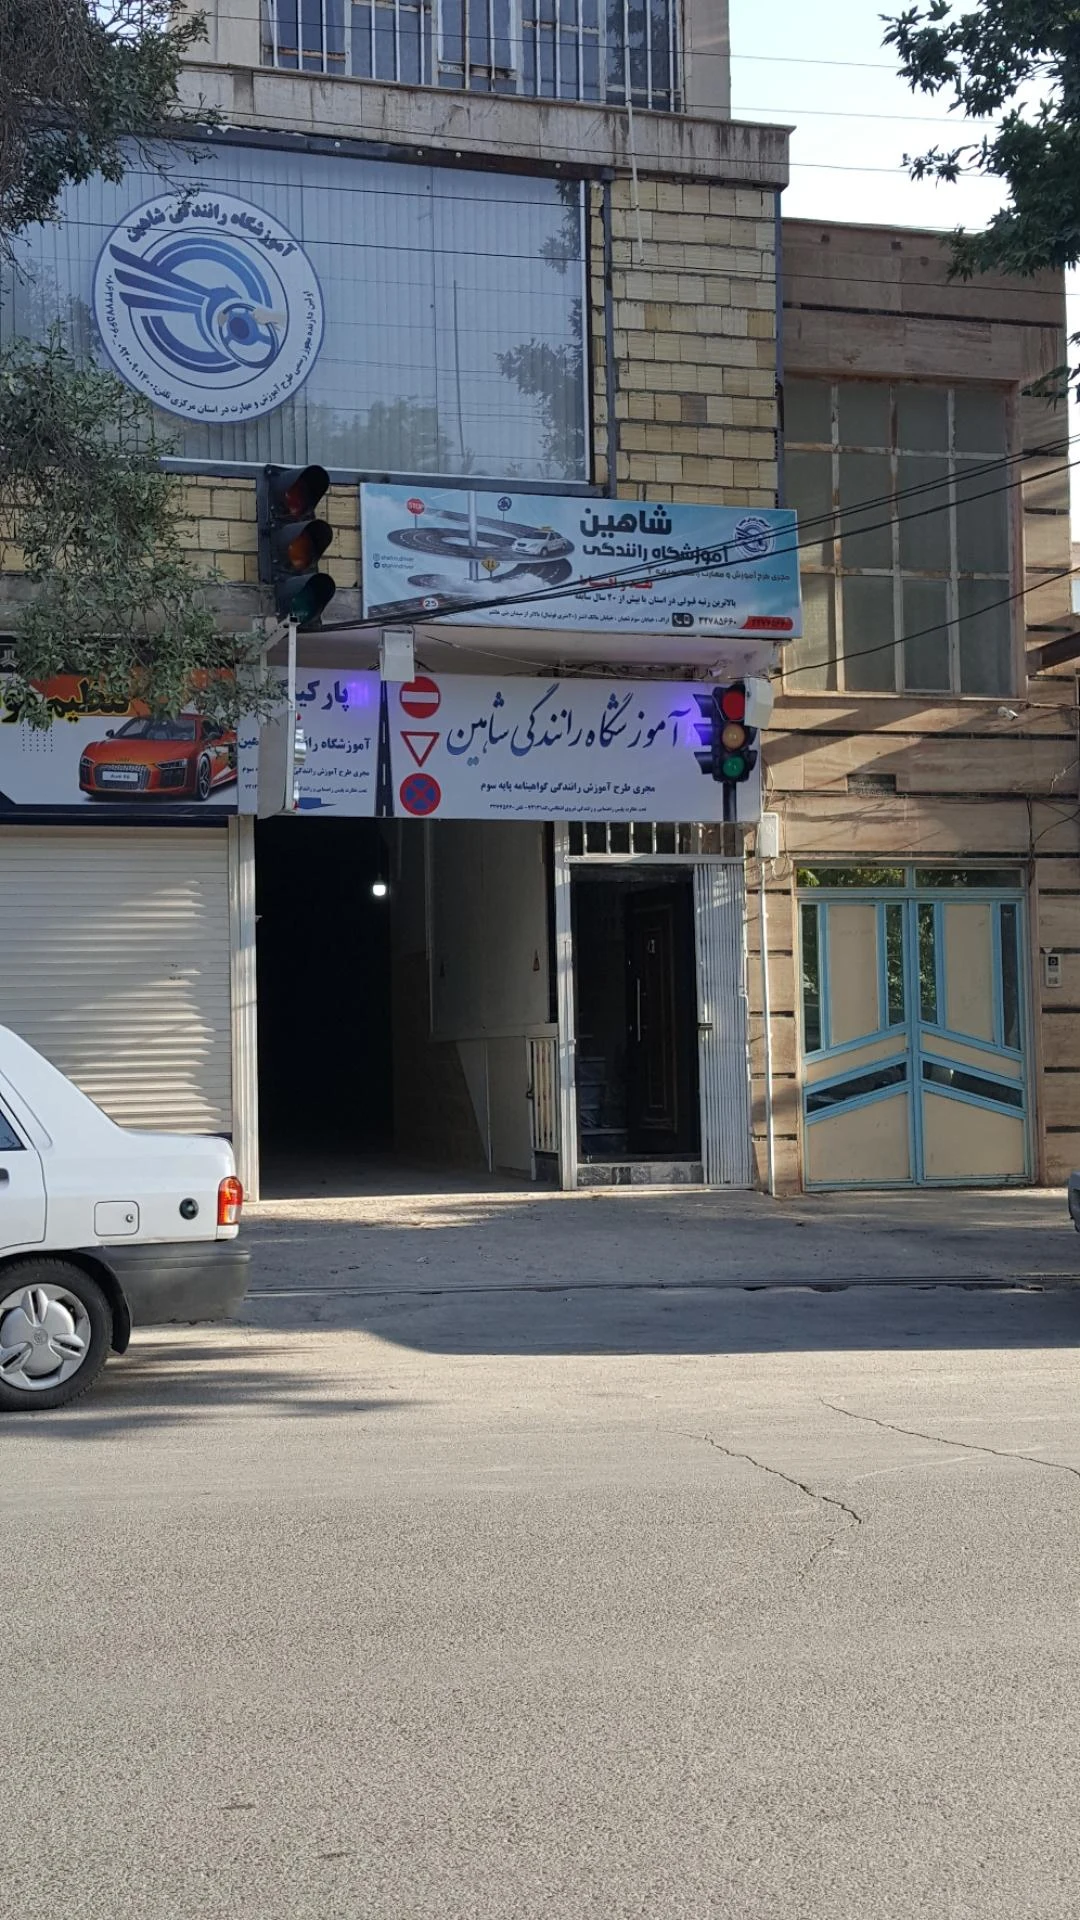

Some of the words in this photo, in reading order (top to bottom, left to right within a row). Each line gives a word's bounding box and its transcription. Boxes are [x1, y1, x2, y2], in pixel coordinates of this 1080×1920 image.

[169, 202, 228, 227] رانندگی
[126, 207, 166, 243] شاهین
[230, 211, 298, 257] آموزشگاه
[280, 372, 294, 390] طرح
[259, 382, 281, 406] آموزش
[170, 399, 196, 411] مرکزی
[197, 404, 218, 414] استان
[220, 406, 230, 416] در
[230, 402, 252, 414] مهارت
[579, 504, 672, 539] شاهین
[652, 543, 729, 565] آموزشگاه
[712, 598, 737, 609] بالاترین
[510, 682, 582, 757] رانندگی
[586, 691, 692, 748] آموزشگاه
[447, 691, 510, 767] شاهین
[321, 737, 371, 754] آموزشگاه
[317, 767, 337, 776] آموزش
[339, 768, 352, 777] طرح
[480, 782, 497, 792] سوم
[498, 780, 512, 793] پایه
[514, 781, 549, 793] گواهینامه
[550, 782, 582, 794] رانندگی
[583, 781, 612, 794] آموزش
[613, 783, 631, 794] طرح
[633, 785, 656, 795] مجری
